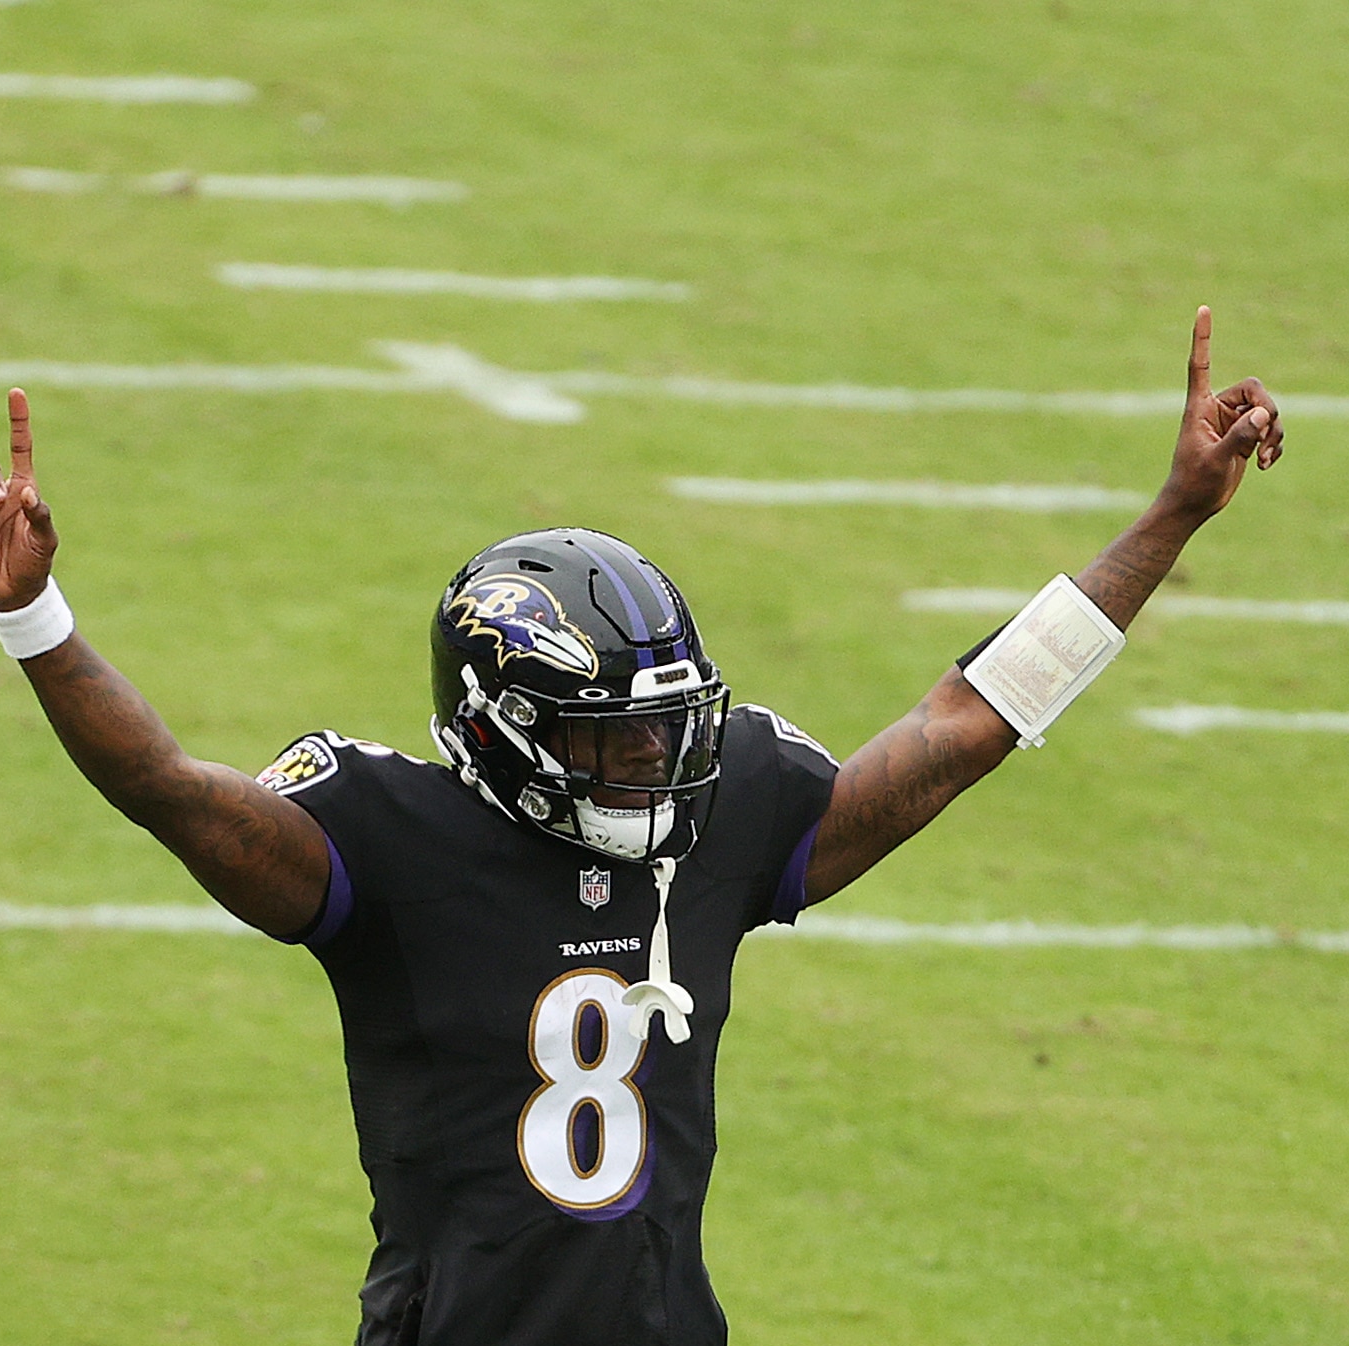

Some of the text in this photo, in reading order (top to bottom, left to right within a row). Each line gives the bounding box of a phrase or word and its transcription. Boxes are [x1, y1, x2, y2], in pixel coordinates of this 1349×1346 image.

[474, 582, 531, 619] B
[585, 885, 606, 901] NFL
[558, 937, 641, 957] RAVENS
[517, 966, 649, 1211] 8
